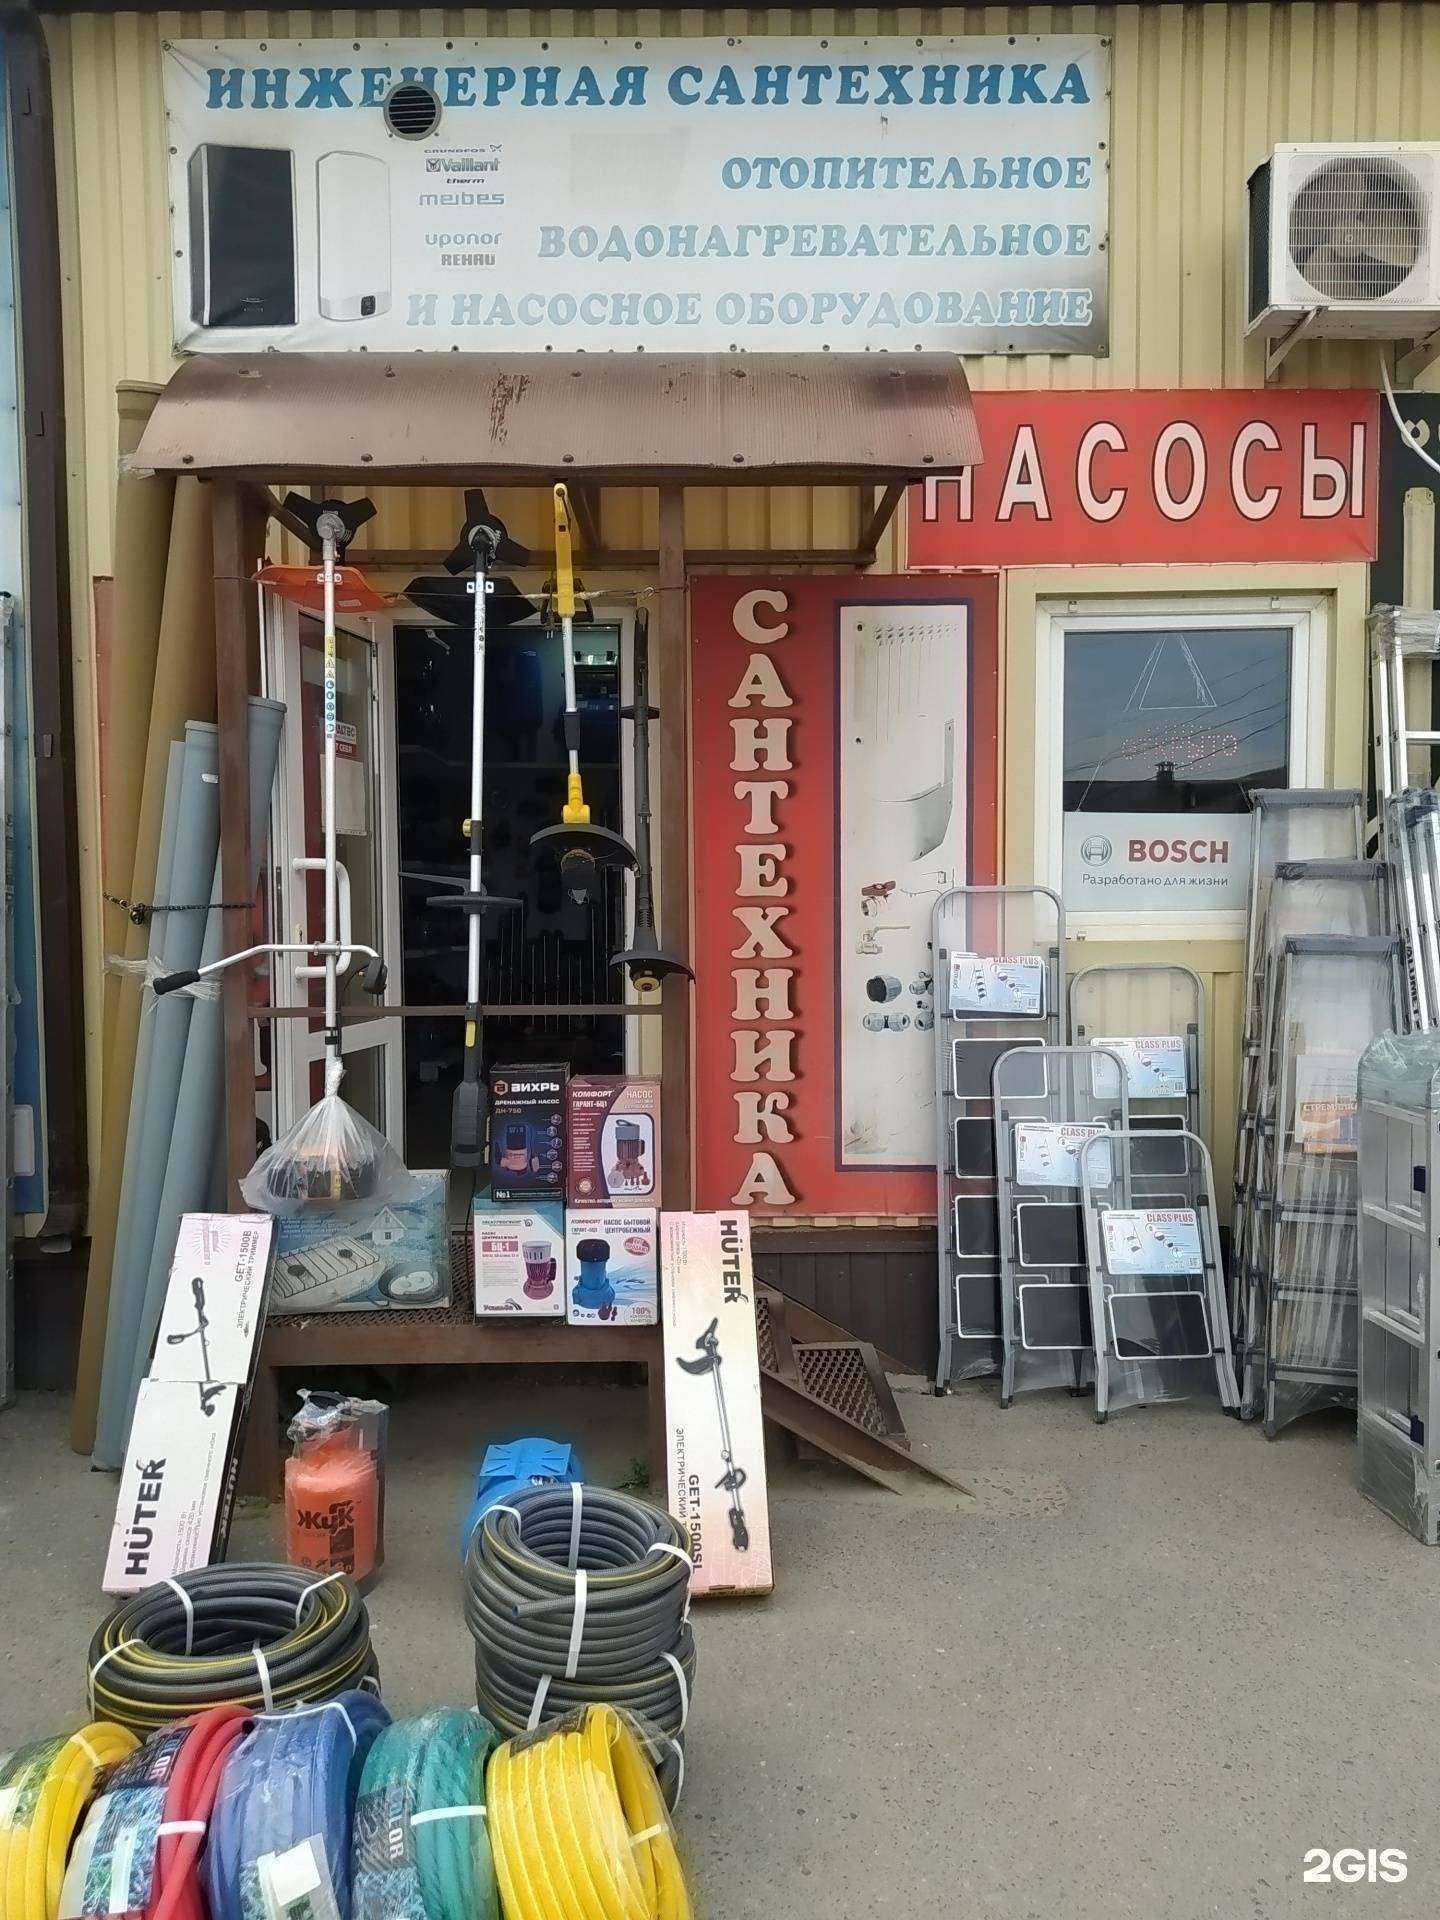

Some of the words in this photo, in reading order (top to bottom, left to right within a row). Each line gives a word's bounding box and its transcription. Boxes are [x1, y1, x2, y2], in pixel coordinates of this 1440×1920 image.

[667, 62, 1091, 105] САНТЕХНИКА
[442, 157, 500, 172] Vaillant
[721, 156, 1092, 190] ОТОПИТЕЛЬНОЕ
[418, 192, 505, 206] meibes
[425, 232, 502, 248] uponor
[538, 223, 1092, 261] ВОДОНАГРЕВАТЕЛЬНОЕ
[441, 253, 496, 266] REHAU
[407, 293, 438, 326] И
[451, 291, 701, 326] НАСОСНОЕ
[715, 289, 1093, 328] ОБОРУДОВАНИЕ
[922, 420, 1367, 523] НАСОСЫ
[1128, 839, 1229, 864] BOSCH
[1082, 873, 1162, 887] Разработано
[1163, 876, 1186, 887] для
[1187, 875, 1229, 887] жизни
[728, 589, 795, 1205] САНТЕХНИКА
[1019, 957, 1040, 965] PLUS
[1136, 1041, 1160, 1049] CLASS
[1161, 1041, 1181, 1049] PLUS
[510, 1082, 560, 1093] ВИХРЬ
[572, 1090, 612, 1098] КОМФОРТ
[626, 1090, 653, 1099] НАСОС
[495, 1098, 537, 1106] ДРЕНАЖНЫЙ
[1061, 1128, 1086, 1137] CLASS
[496, 1191, 510, 1199] №1
[1147, 1213, 1172, 1223] CLASS
[1174, 1213, 1194, 1223] PLUS
[234, 1230, 252, 1283] GET-1500B
[720, 1218, 749, 1305] HÜTER
[236, 1265, 254, 1329] ЭЛЕКТРИЧЕСКИЙ
[246, 1230, 259, 1264] ТРИММЕР
[676, 1427, 688, 1518] ЭЛЕКТРИЧЕСКИЙ
[124, 1457, 167, 1576] HÜTER
